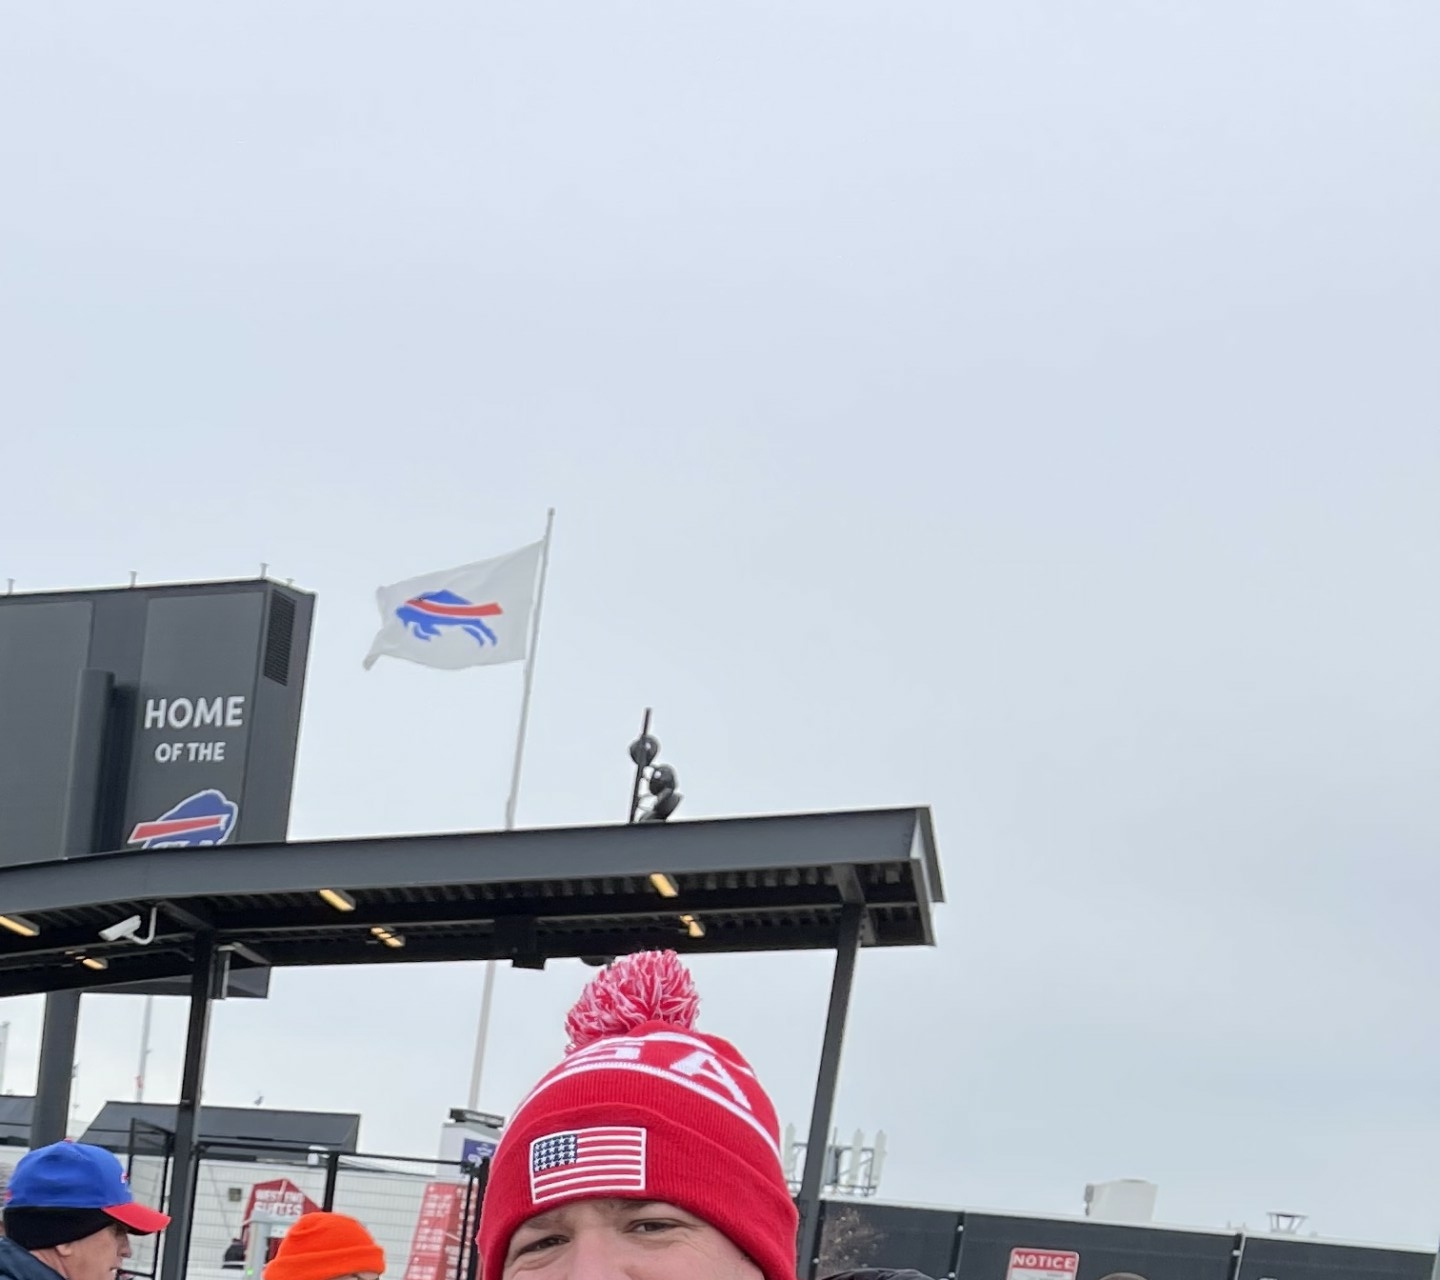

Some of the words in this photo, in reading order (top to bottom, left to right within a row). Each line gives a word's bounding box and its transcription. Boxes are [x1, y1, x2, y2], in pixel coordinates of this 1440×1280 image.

[144, 696, 246, 729] HOME
[155, 742, 184, 763] OF
[186, 741, 226, 762] THE
[1013, 1254, 1076, 1270] NOTICE
